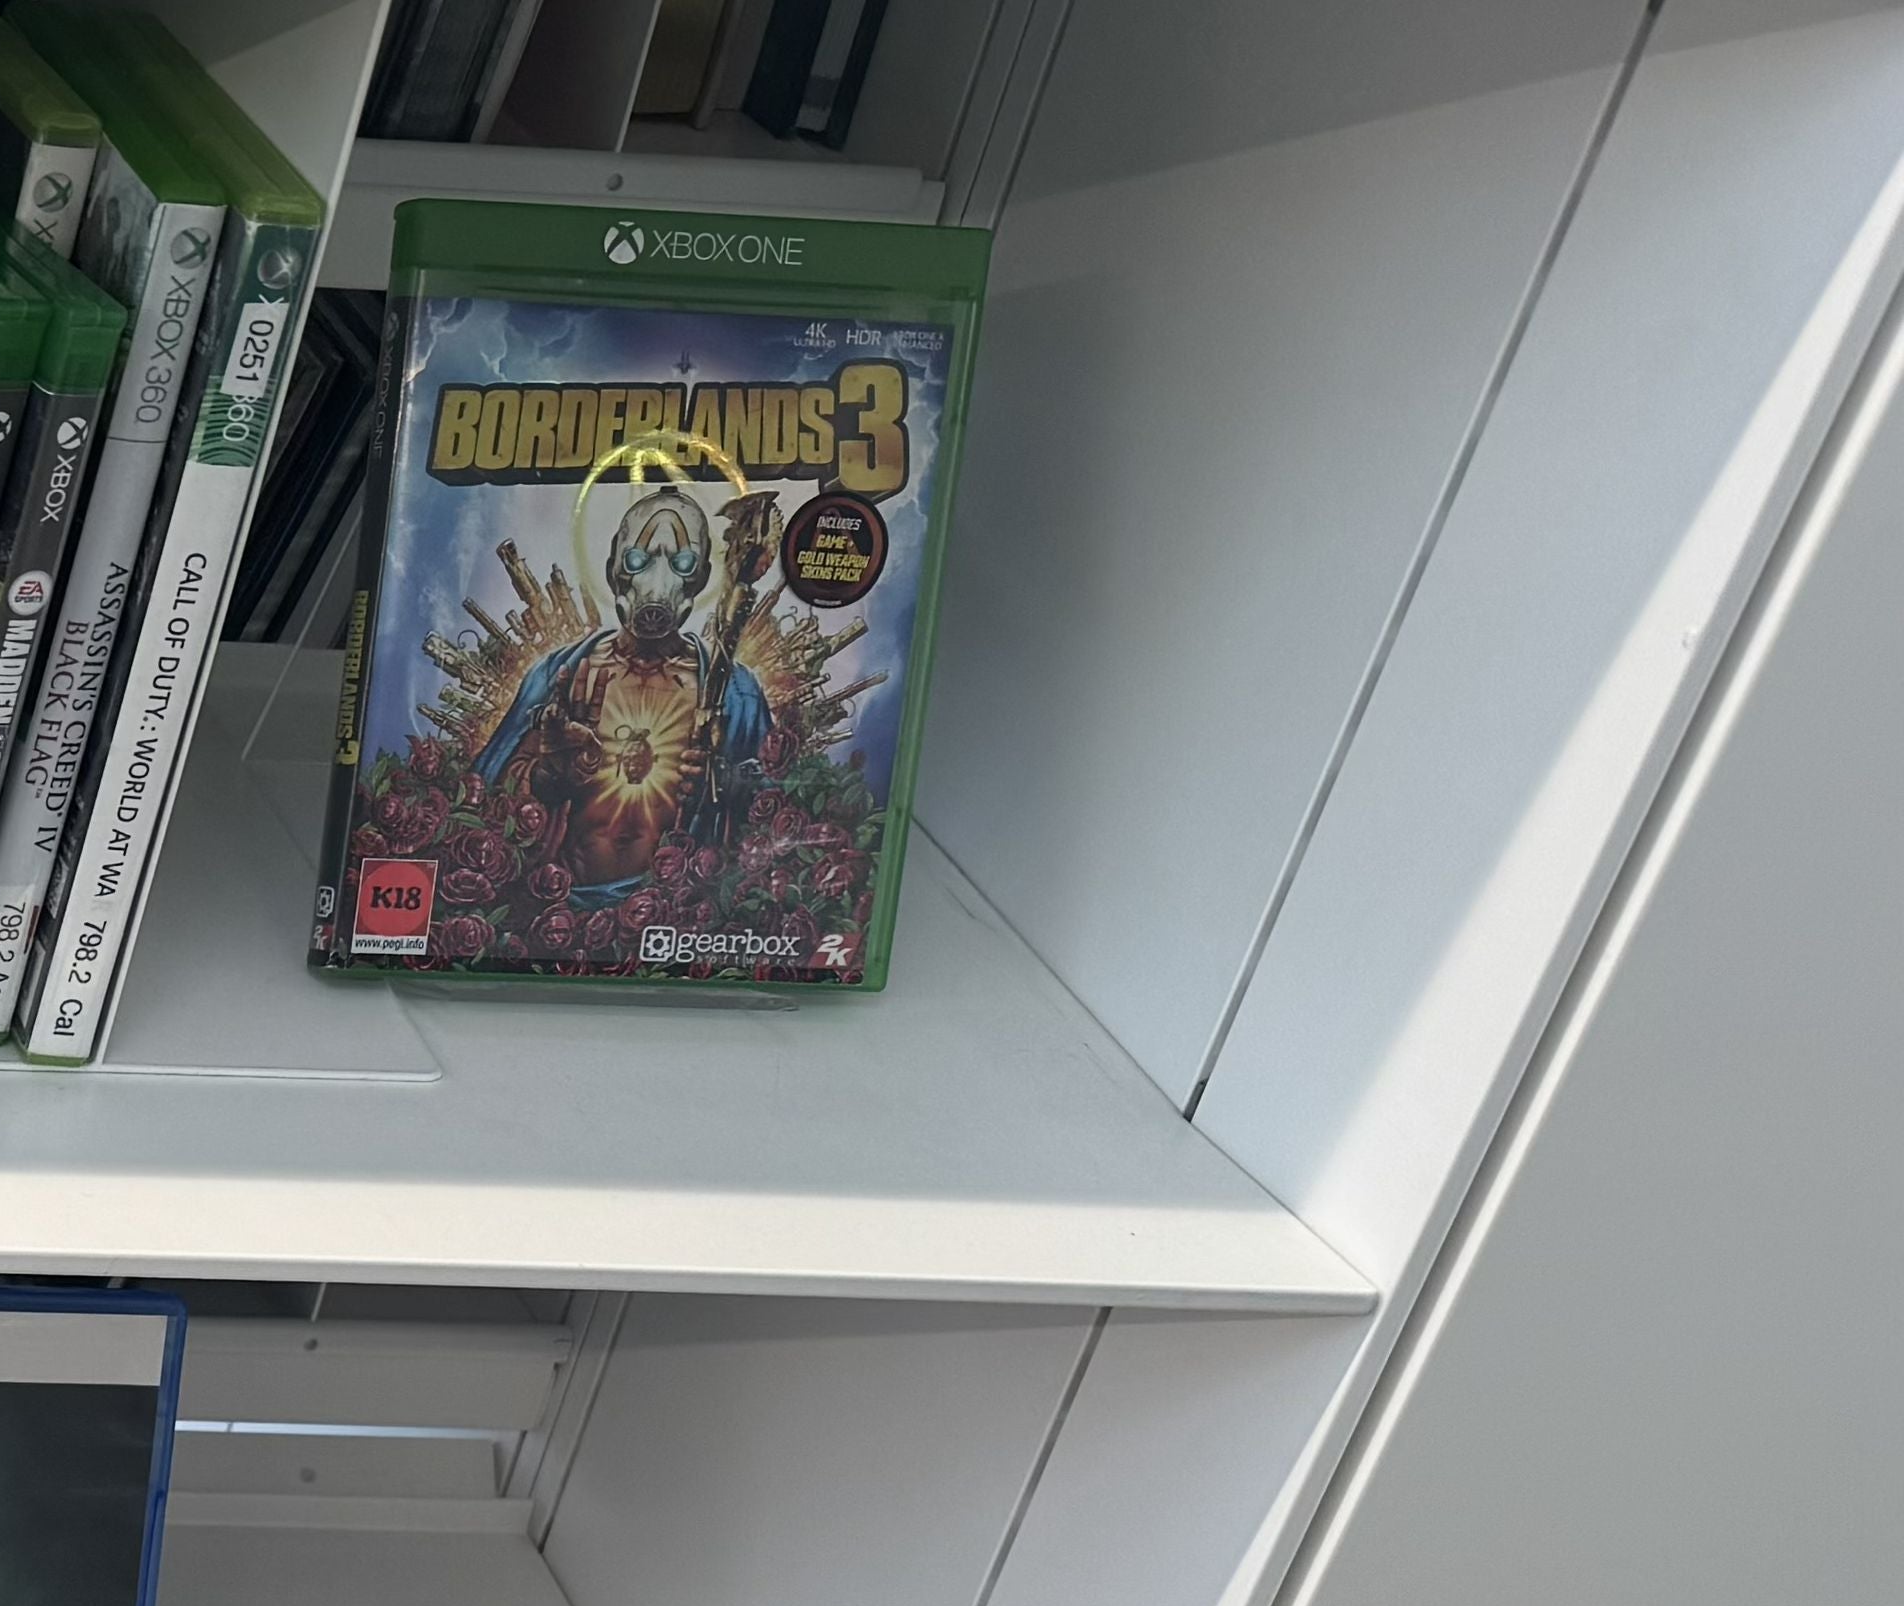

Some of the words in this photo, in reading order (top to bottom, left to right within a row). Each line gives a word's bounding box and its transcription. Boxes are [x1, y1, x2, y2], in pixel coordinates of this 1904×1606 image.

[805, 323, 826, 337] 4K
[846, 329, 882, 346] HDR
[235, 319, 273, 383] 0251
[438, 386, 835, 472] BORDERLANDS
[839, 364, 906, 491] 3
[40, 455, 76, 523] XBOX
[816, 515, 862, 531] INCLUDES
[816, 535, 847, 548] GAME
[797, 551, 825, 566] GOLD
[825, 553, 870, 569] WEAPON
[833, 568, 862, 582] PACK
[172, 552, 207, 611] CALL
[163, 617, 189, 650] OF
[48, 620, 89, 710] BLACK
[25, 718, 61, 786] FLAG
[118, 737, 157, 822] WORLD
[109, 827, 130, 857] AT
[370, 886, 422, 910] K18
[675, 929, 801, 963] gearbox
